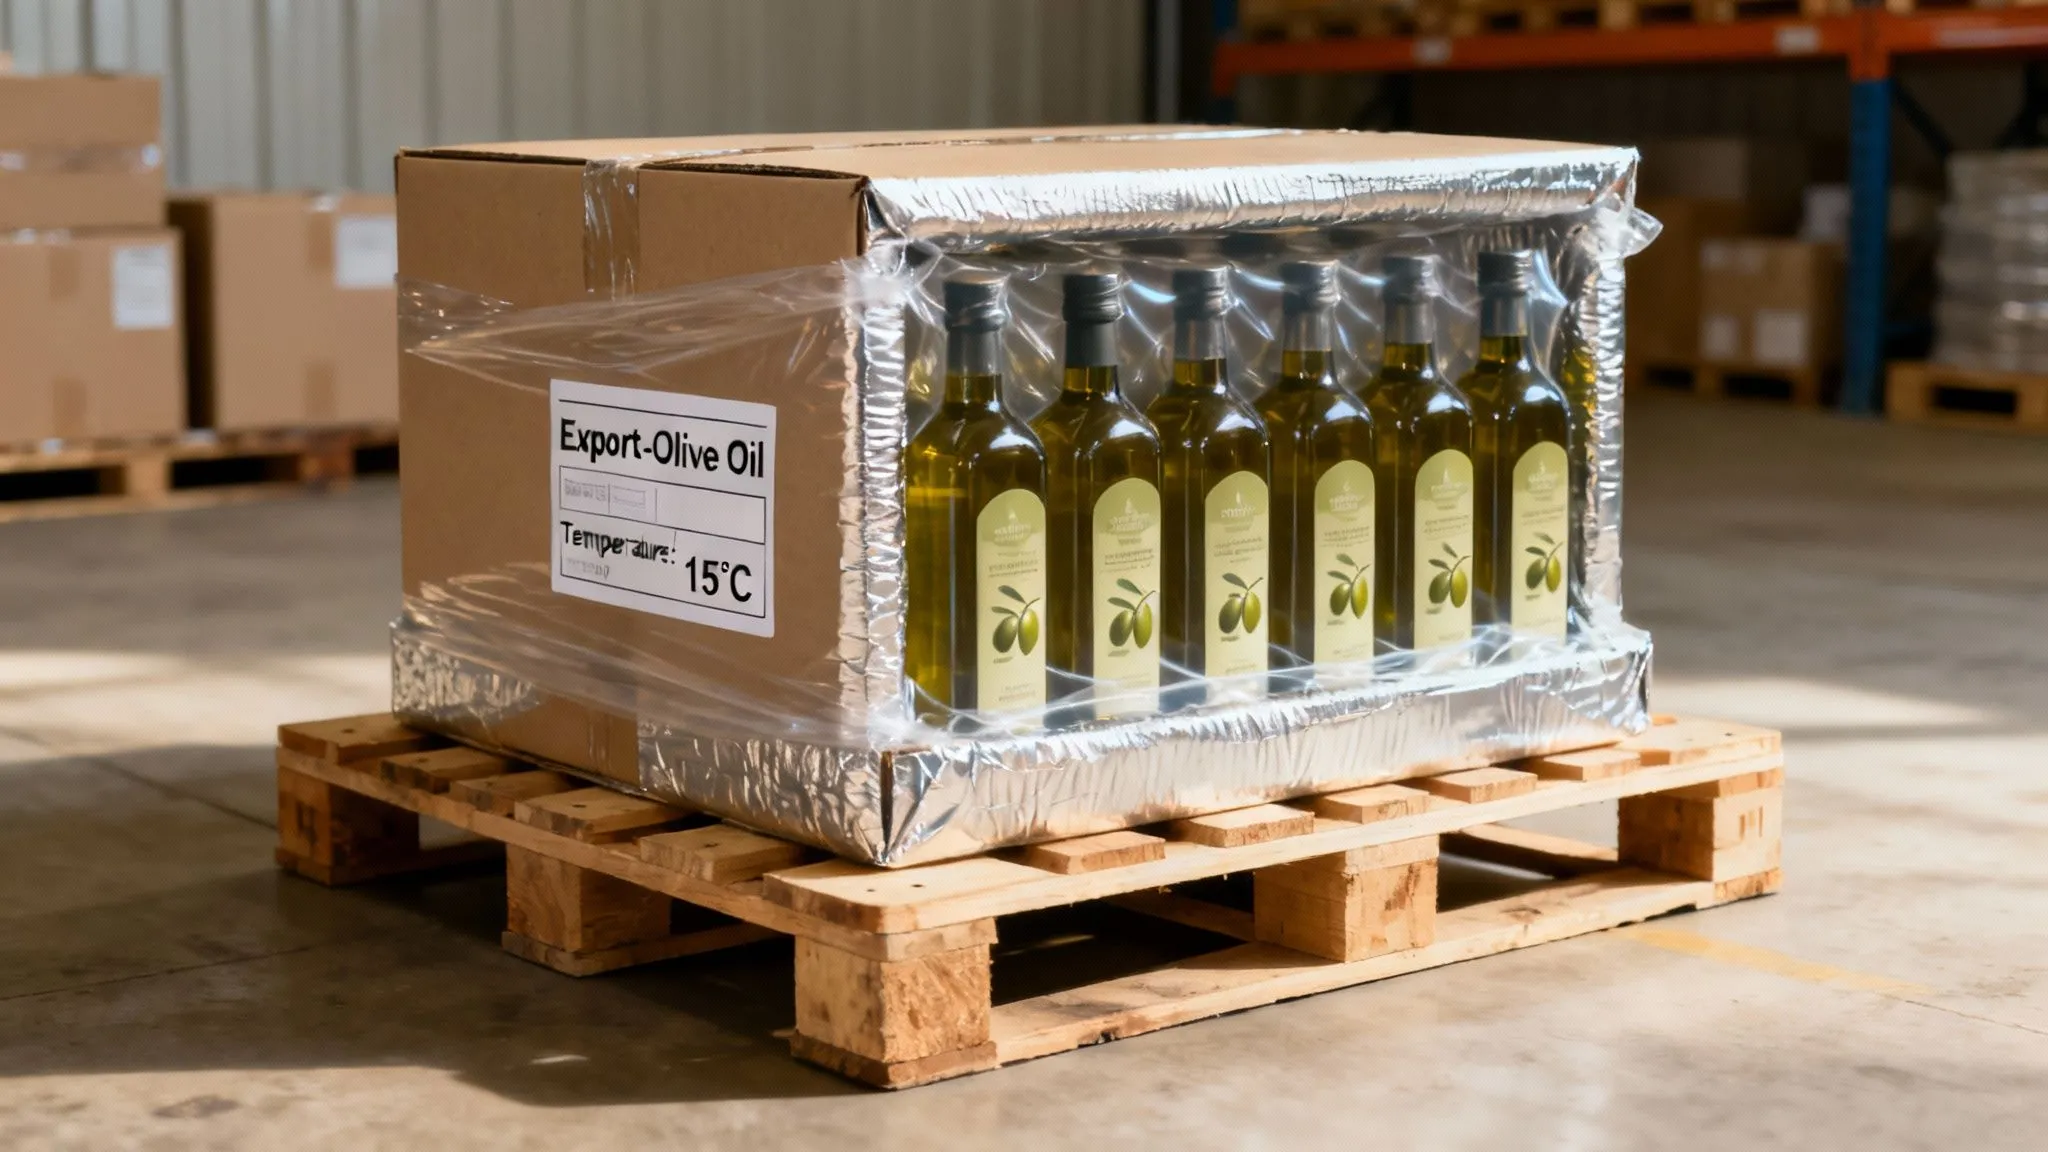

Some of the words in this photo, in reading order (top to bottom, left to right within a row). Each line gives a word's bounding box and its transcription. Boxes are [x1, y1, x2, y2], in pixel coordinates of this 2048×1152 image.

[560, 417, 719, 471] Export-Olive
[727, 439, 764, 478] Oil
[685, 555, 752, 602] 15°C
